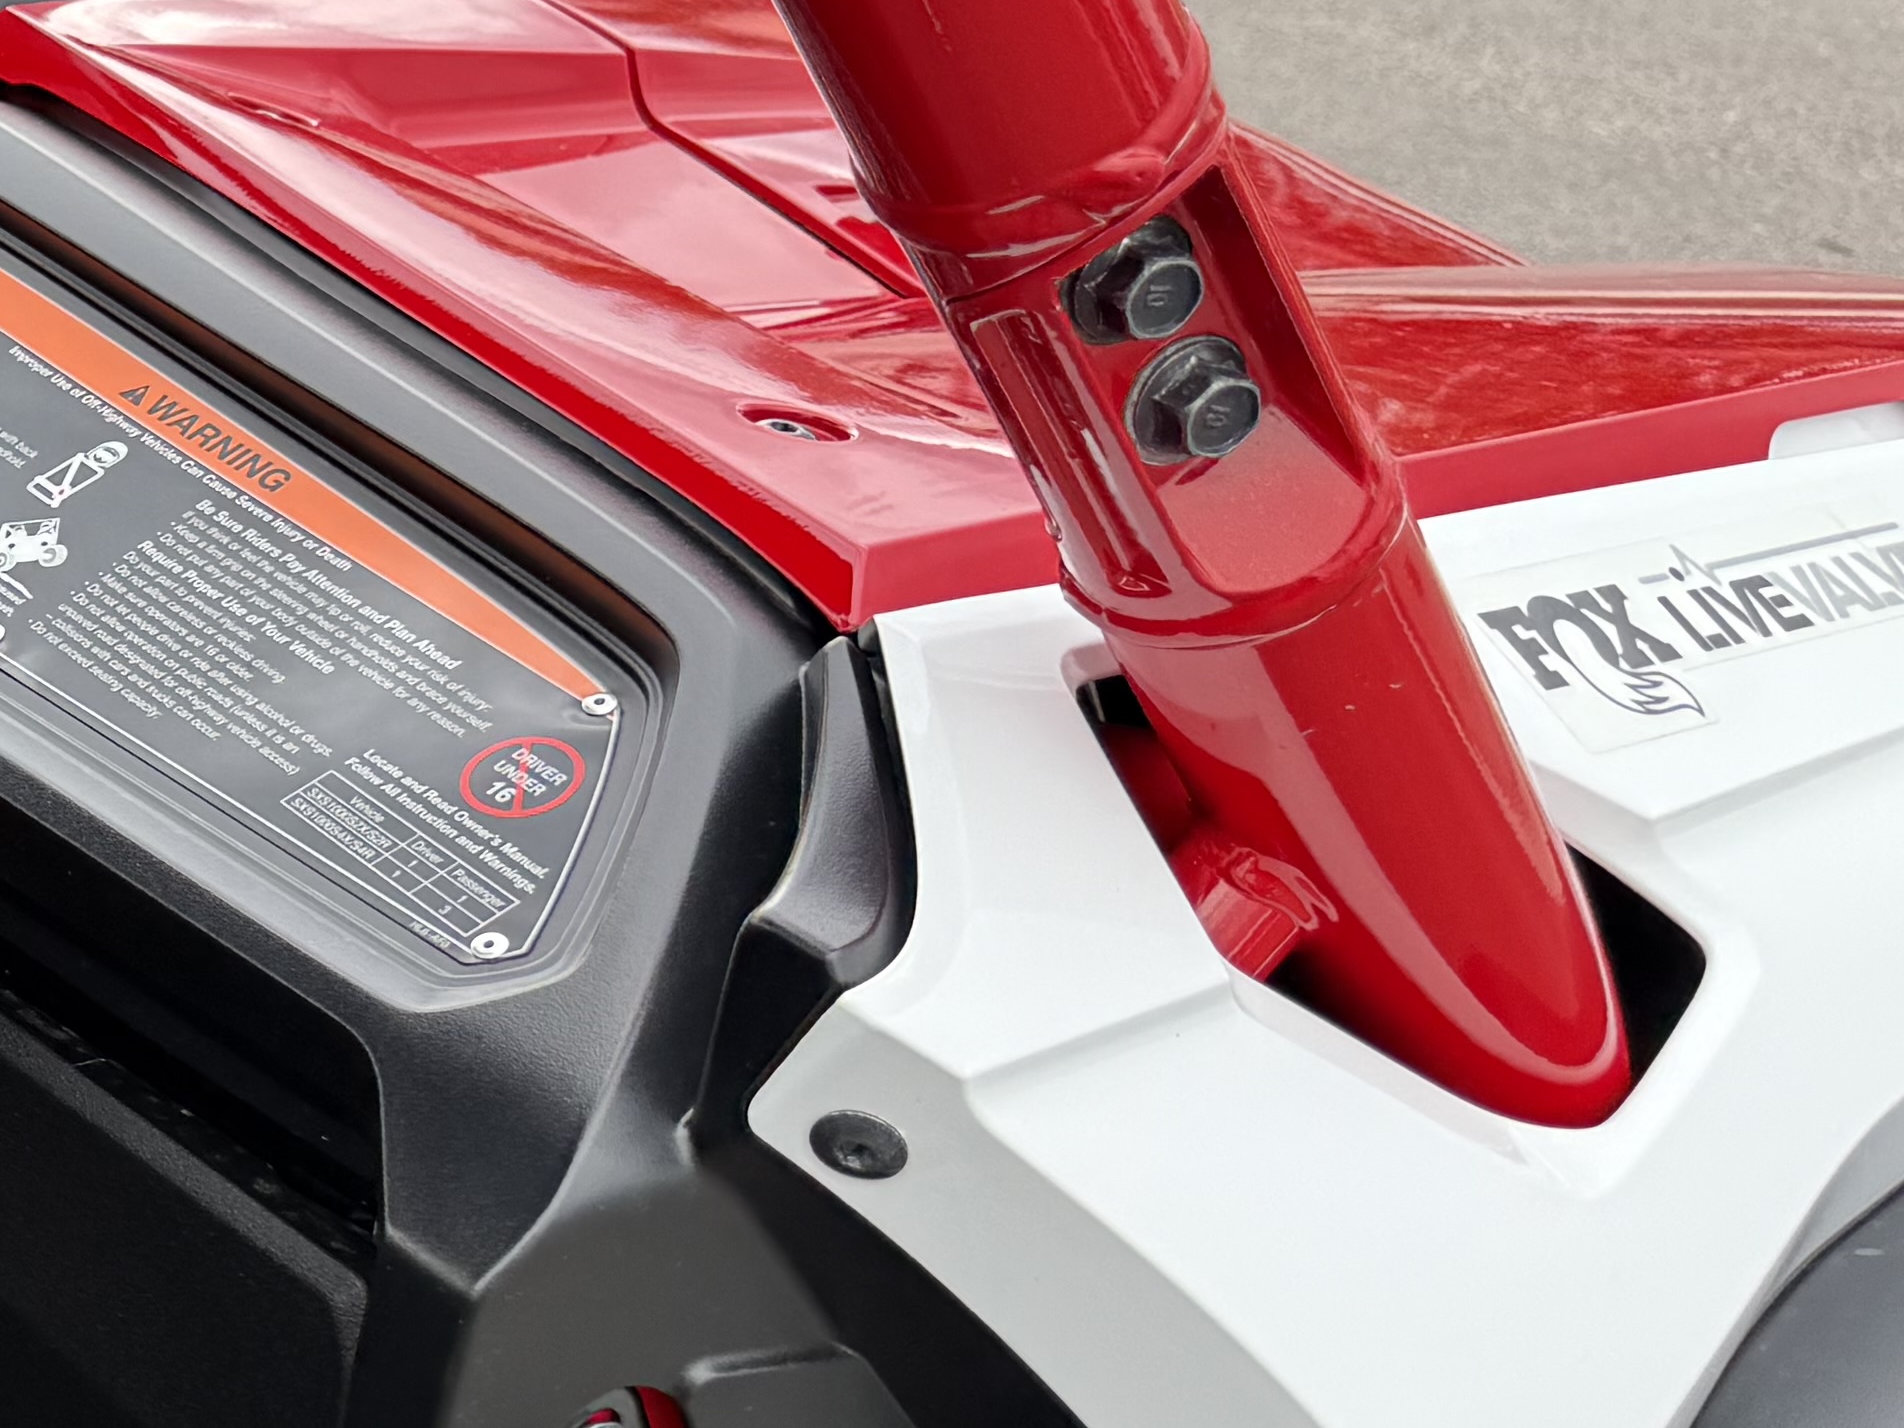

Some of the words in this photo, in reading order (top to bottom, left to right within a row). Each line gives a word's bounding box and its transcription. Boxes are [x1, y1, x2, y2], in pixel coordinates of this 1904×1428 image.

[146, 394, 291, 492] WARNING
[8, 345, 53, 376] Improper
[49, 372, 73, 391] Use
[68, 387, 87, 399] of
[81, 394, 142, 437] Off-Highway
[139, 431, 182, 464] Vehicles
[179, 459, 205, 478] Can
[202, 474, 237, 499] Cause
[234, 494, 273, 522] Severe
[270, 517, 306, 542] Injury
[301, 538, 320, 550] or
[315, 545, 352, 571] Death
[180, 509, 196, 519] If
[185, 515, 209, 531] you
[158, 531, 177, 547] Do
[205, 526, 231, 544] think
[171, 542, 194, 557] not
[226, 541, 243, 551] or
[238, 547, 261, 562] feel
[184, 552, 209, 567] put
[255, 558, 275, 573] the
[202, 563, 225, 579] any
[194, 498, 216, 516] Be
[212, 510, 243, 532] Sure
[240, 528, 282, 557] Riders
[277, 551, 307, 574] Pay
[301, 569, 361, 608] Attention
[356, 604, 391, 625] and
[383, 619, 416, 642] Plan
[412, 639, 462, 669] Ahead
[218, 575, 244, 590] part
[272, 571, 307, 593] vehicle
[238, 586, 257, 597] of
[303, 590, 329, 608] may
[136, 540, 183, 573] Require
[180, 569, 224, 599] Proper
[219, 594, 248, 617] Use
[244, 613, 267, 626] of
[260, 620, 291, 644] Your
[288, 639, 334, 674] Vehicle
[247, 594, 274, 609] your
[324, 602, 342, 616] tip
[100, 573, 127, 594] Make
[123, 592, 147, 607] sure
[144, 605, 188, 636] operators
[184, 633, 205, 648] are
[202, 643, 220, 657] 16
[213, 652, 230, 663] or
[113, 562, 132, 578] Do
[126, 574, 148, 588] not
[142, 585, 169, 603] allow
[165, 601, 206, 628] careless
[201, 625, 218, 635] or
[213, 633, 254, 661] reckless
[173, 523, 199, 542] Keep
[195, 539, 208, 549] a
[204, 544, 225, 559] firm
[219, 557, 243, 571] grip
[239, 568, 257, 581] on
[251, 575, 272, 591] the
[268, 587, 309, 615] steering
[306, 611, 339, 632] wheel
[333, 629, 349, 640] or
[345, 636, 398, 672] handholds
[394, 669, 423, 686] and
[415, 681, 447, 704] brace
[270, 607, 298, 627] body
[337, 612, 355, 622] or
[1478, 584, 1691, 703] FOX
[1763, 542, 1904, 621] VALV
[294, 623, 332, 648] outside
[327, 645, 347, 656] of
[368, 632, 406, 657] reduce
[339, 651, 360, 667] the
[400, 654, 430, 670] your
[357, 664, 394, 689] vehicle
[426, 669, 449, 684] risk
[390, 684, 411, 699] for
[444, 680, 465, 692] of
[405, 696, 431, 713] any
[511, 747, 567, 785] DRIVER
[493, 759, 546, 796] UNDER
[362, 748, 403, 778] Locate
[399, 775, 430, 794] and
[422, 789, 458, 814] Read
[453, 810, 502, 846] Owner's
[485, 781, 516, 802] 16
[344, 756, 384, 785] Follow
[378, 782, 402, 797] All
[395, 792, 458, 838] Instruction
[453, 834, 485, 854] and
[349, 795, 384, 822] Vehicle
[410, 840, 444, 863] Driver
[450, 868, 506, 907] Passenger
[437, 904, 452, 914] 3
